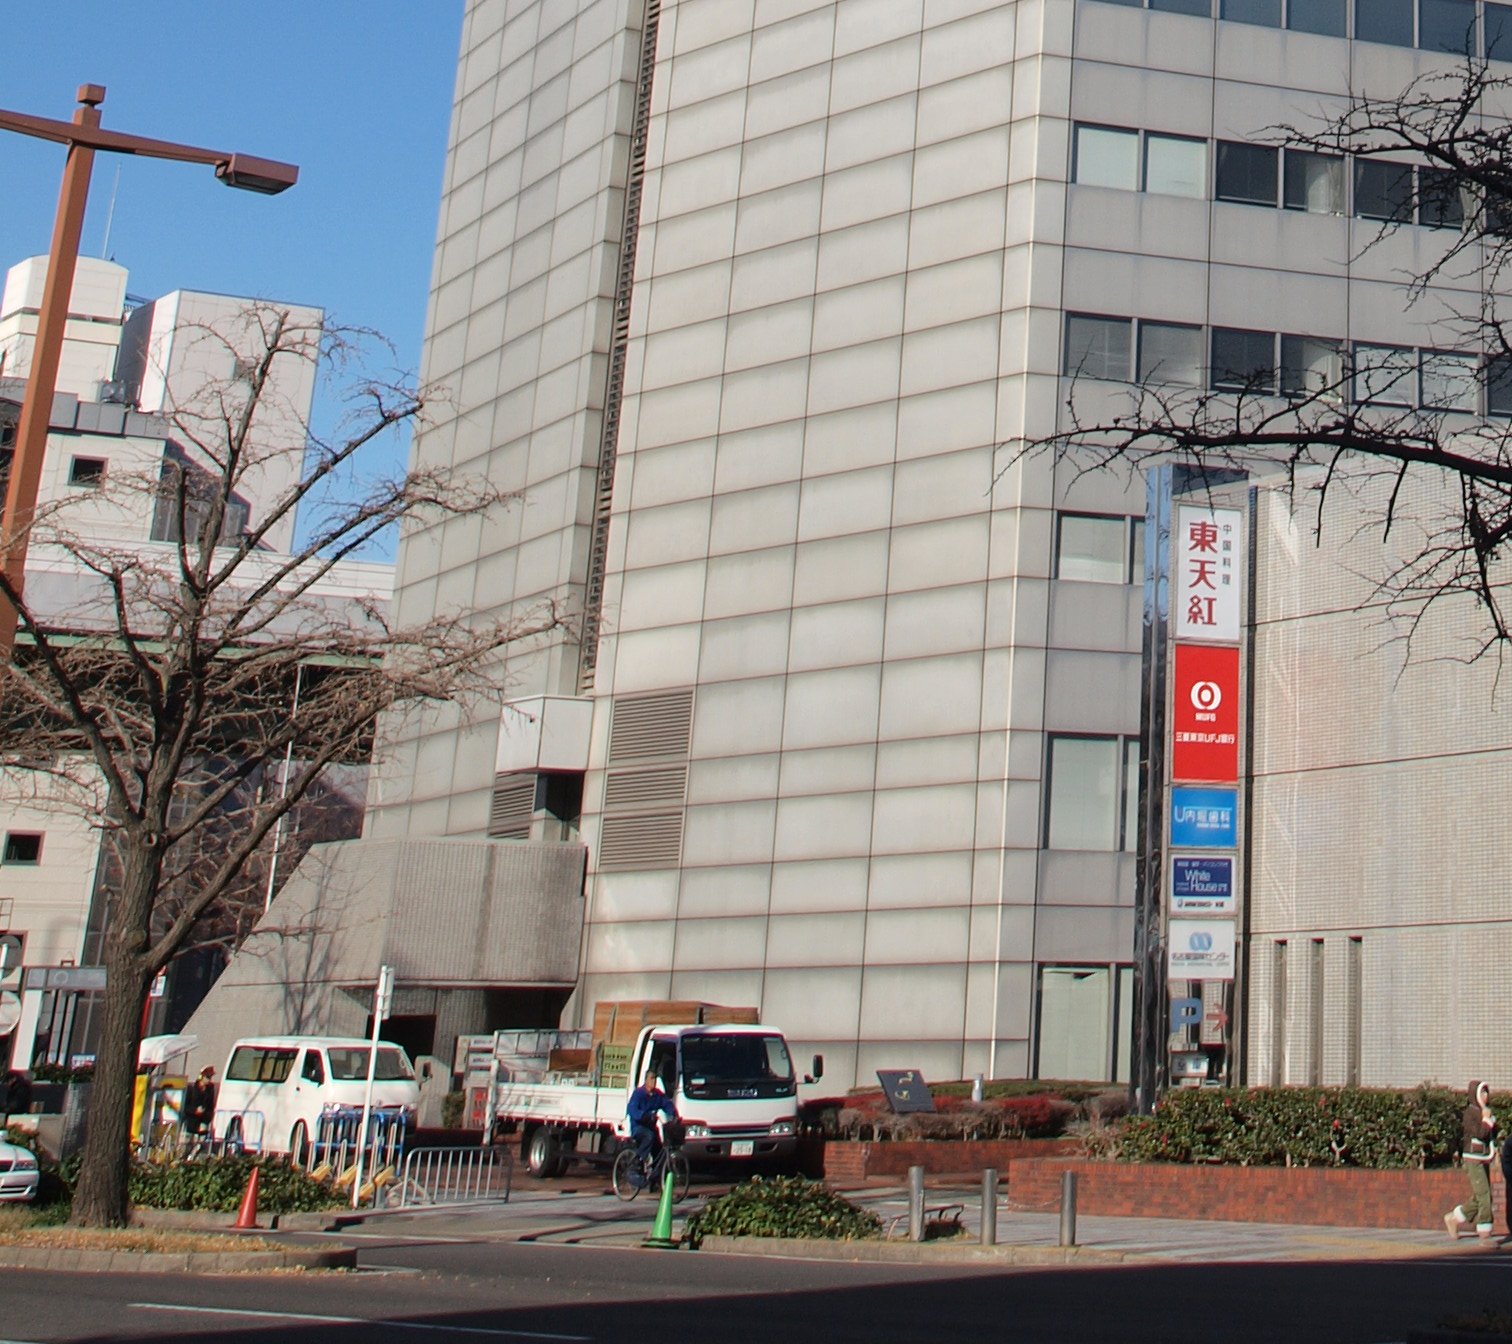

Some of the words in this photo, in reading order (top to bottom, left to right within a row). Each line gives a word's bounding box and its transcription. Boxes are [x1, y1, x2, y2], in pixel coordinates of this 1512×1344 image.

[1187, 520, 1218, 626] 東天紅
[1222, 523, 1232, 586] 中国料理
[1170, 997, 1203, 1033] P
